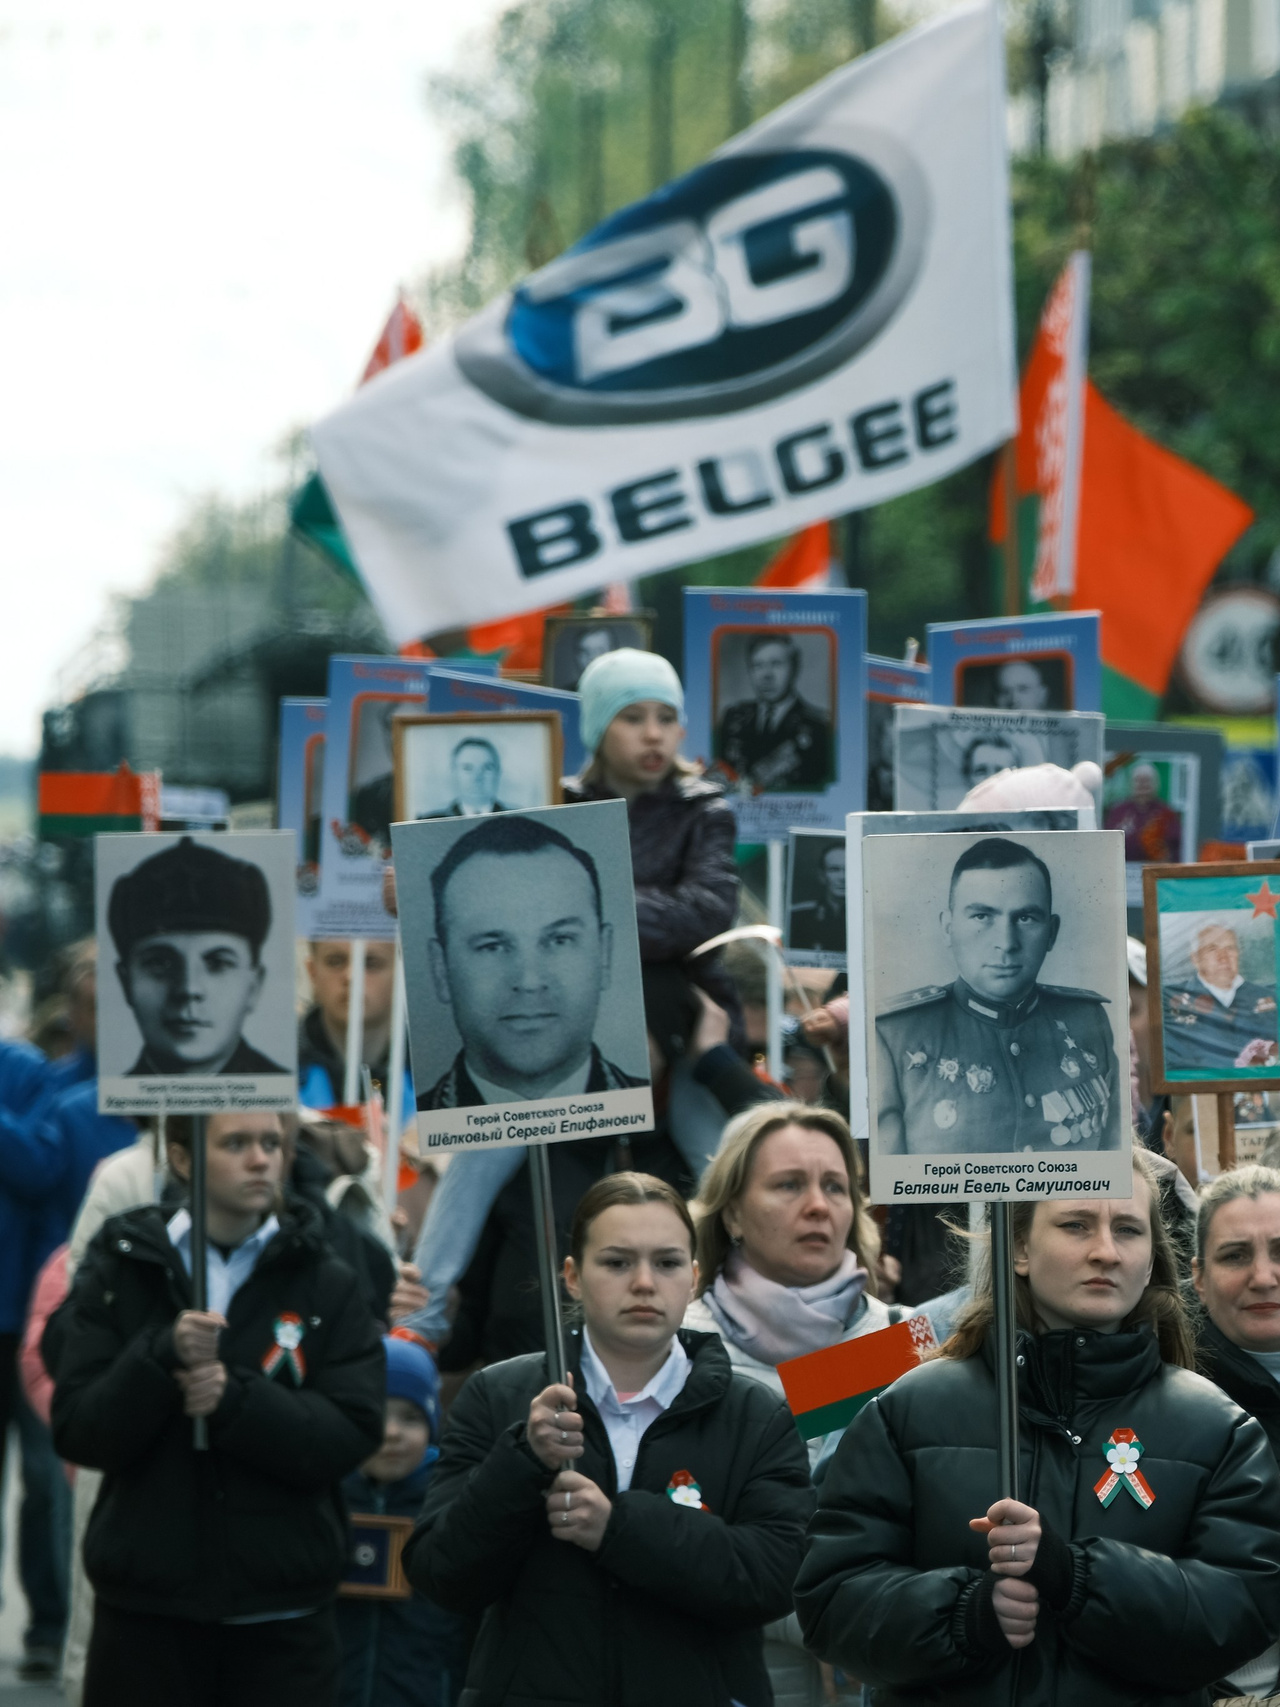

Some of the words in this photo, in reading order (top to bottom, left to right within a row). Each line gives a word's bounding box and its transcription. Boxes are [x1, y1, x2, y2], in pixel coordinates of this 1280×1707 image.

[507, 377, 961, 580] BELGEE
[466, 1112, 501, 1126] Герой
[503, 1108, 567, 1122] Советского
[569, 1102, 605, 1115] Союза
[428, 1128, 503, 1147] Шёлковый
[507, 1122, 557, 1141] Сергей
[560, 1114, 647, 1134] Епифанович
[924, 1163, 961, 1178] Герой
[964, 1162, 1034, 1174] Советского
[1037, 1161, 1078, 1173] Союза
[893, 1181, 959, 1195] Белявин
[963, 1179, 1011, 1194] Евель
[1015, 1178, 1111, 1195] Самуилович
